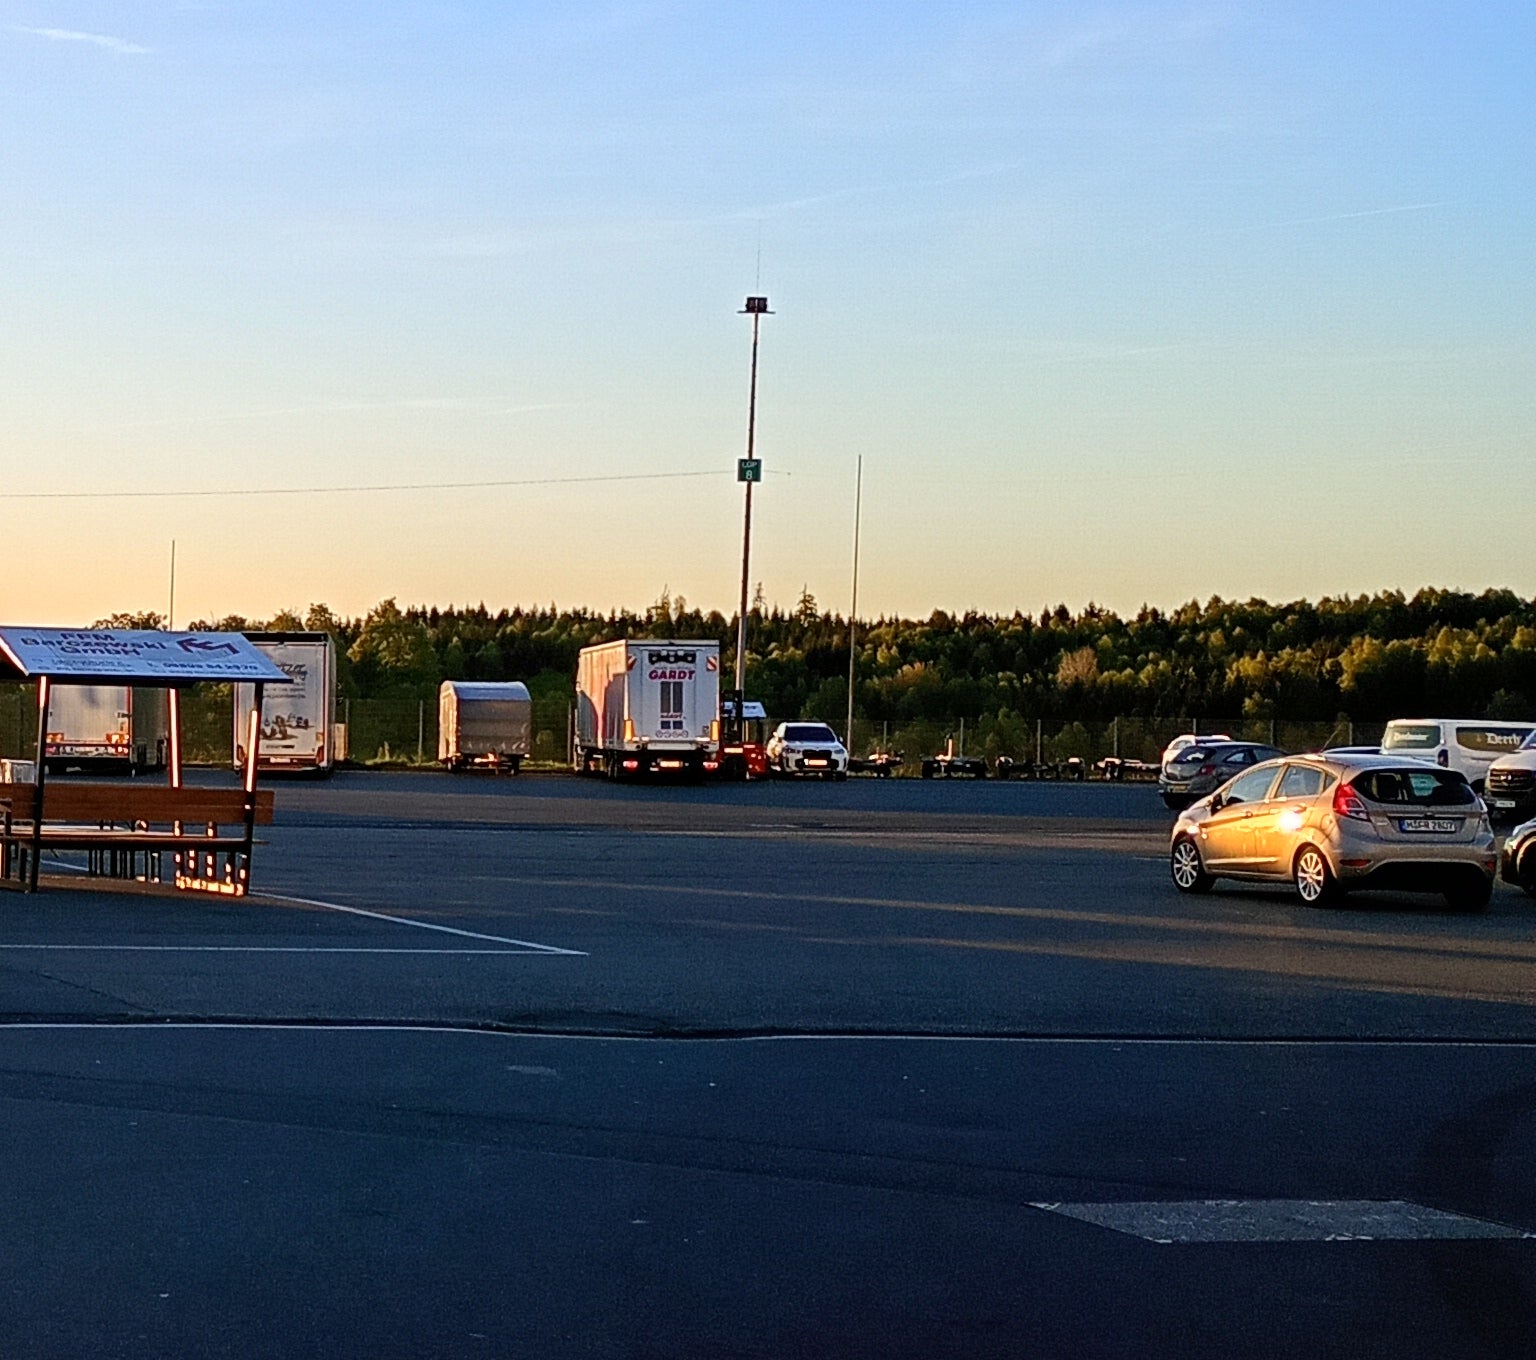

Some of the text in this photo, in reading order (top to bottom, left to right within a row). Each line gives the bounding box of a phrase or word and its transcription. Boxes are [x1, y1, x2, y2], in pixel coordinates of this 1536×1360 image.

[746, 470, 753, 479] 8
[60, 646, 141, 656] GmbH
[649, 670, 695, 680] GARDT
